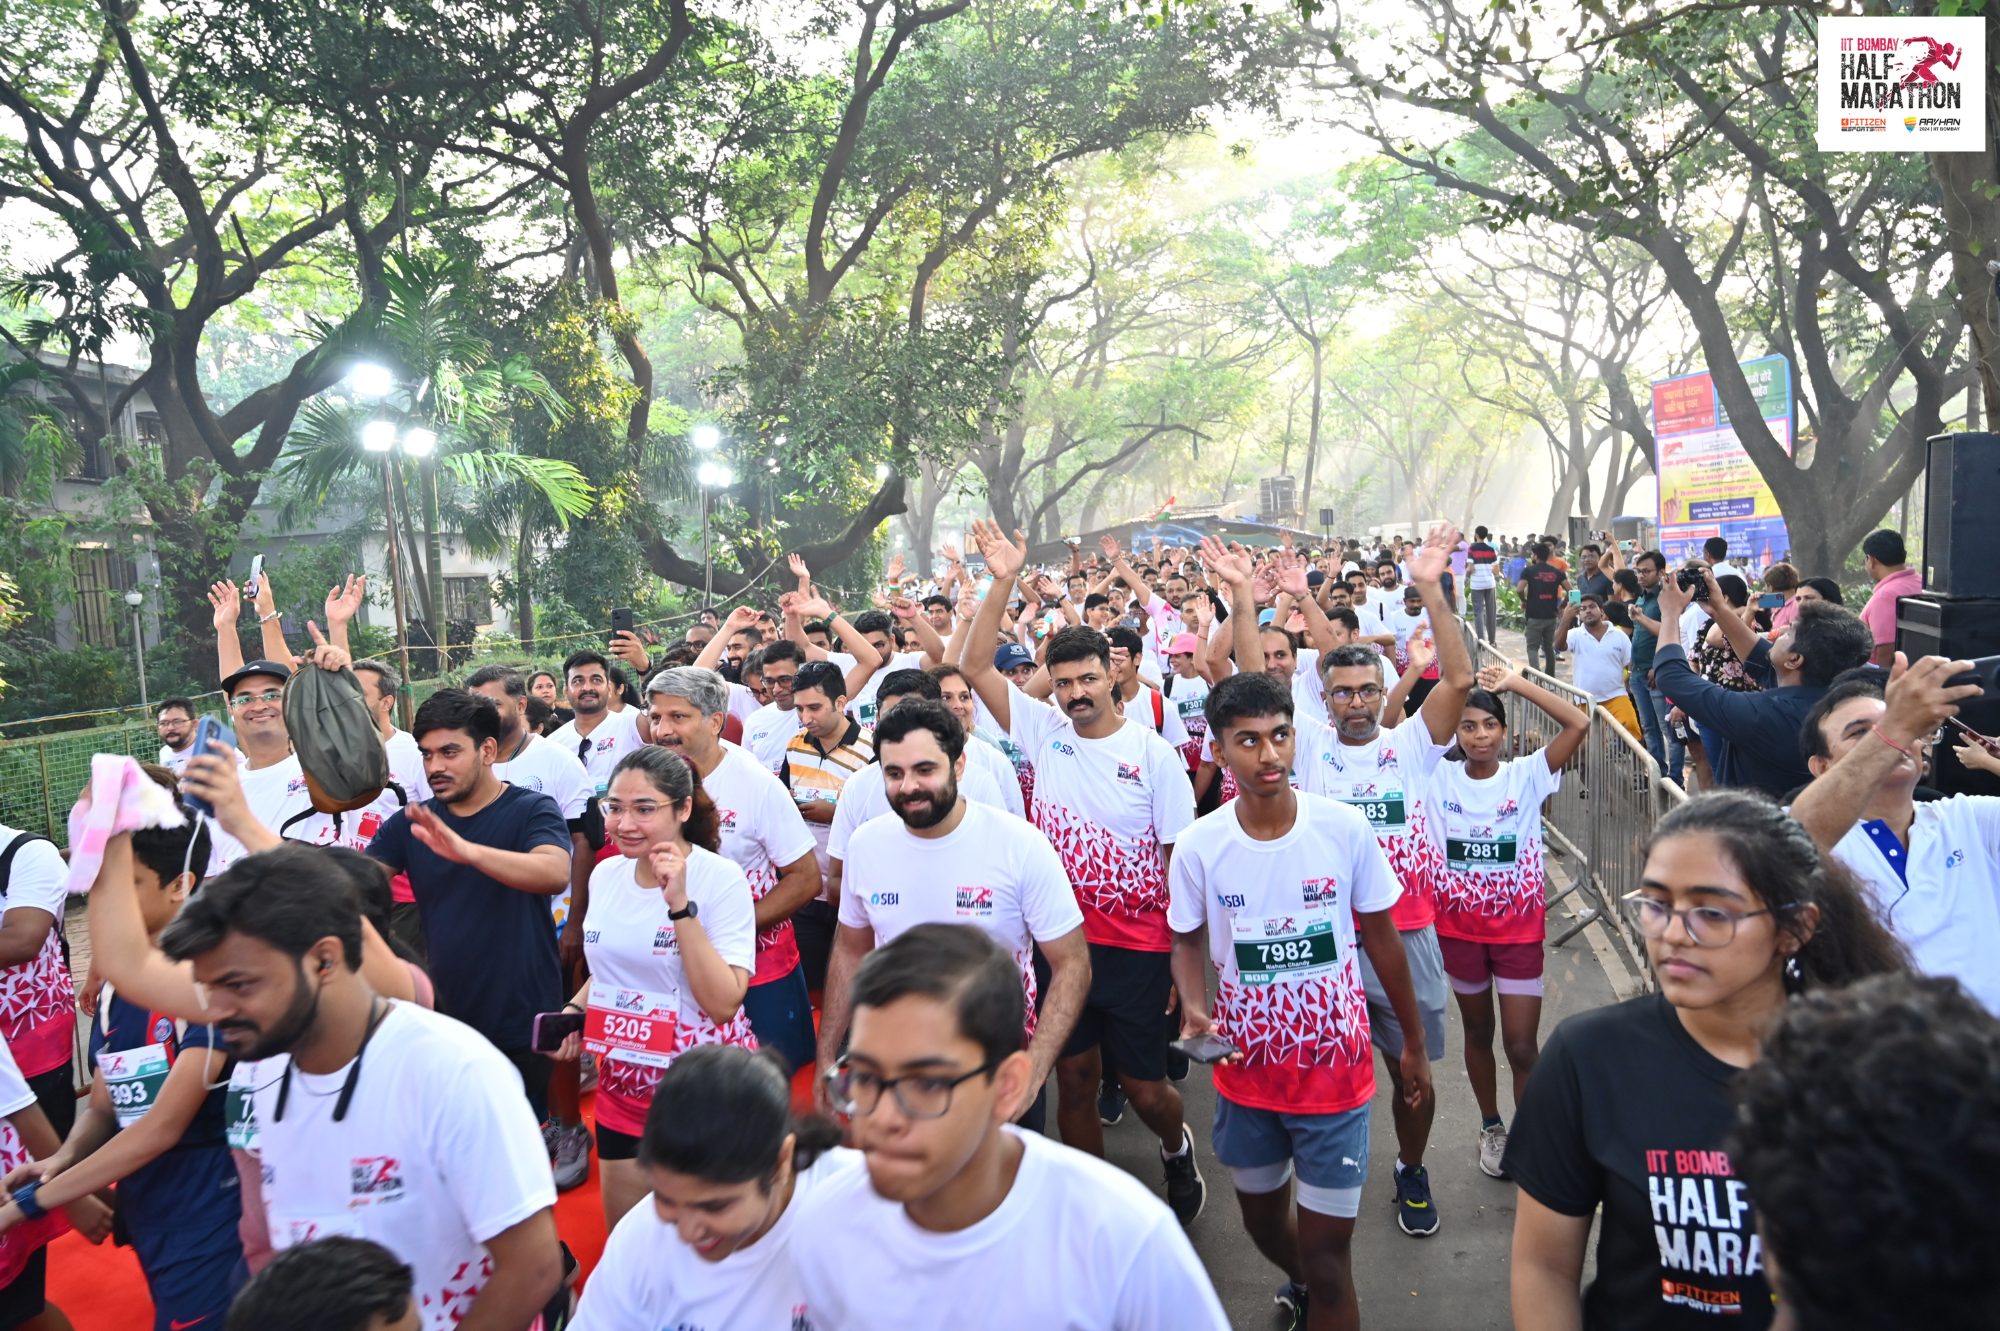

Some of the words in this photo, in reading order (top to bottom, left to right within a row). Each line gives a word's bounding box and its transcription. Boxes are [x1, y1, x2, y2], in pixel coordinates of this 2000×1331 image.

[1184, 700, 1203, 710] 7307
[1060, 744, 1074, 757] SBI
[1448, 802, 1462, 815] SBI
[1462, 843, 1500, 858] 7981
[1302, 883, 1319, 893] HALF
[880, 892, 899, 905] SBI
[956, 891, 972, 900] HALF
[1225, 894, 1246, 908] SBI
[1303, 891, 1337, 903] MARATHON
[956, 901, 993, 909] MARATHON
[1264, 921, 1278, 931] HALF
[1265, 926, 1298, 937] MARATHON
[585, 930, 601, 944] SBI
[655, 930, 673, 939] HALF
[653, 939, 680, 949] MARAT
[1257, 939, 1314, 963] 7982
[1287, 959, 1310, 968] Chandy
[615, 1000, 644, 1012] MARATHON
[603, 1014, 652, 1041] 5205
[107, 1081, 148, 1105] 393
[1646, 1150, 1669, 1174] IIT
[1674, 1150, 1736, 1176] BOMB
[1648, 1175, 1749, 1229] HALF
[1676, 1282, 1741, 1304] FITIZEN
[1672, 1294, 1721, 1314] SPORTS
